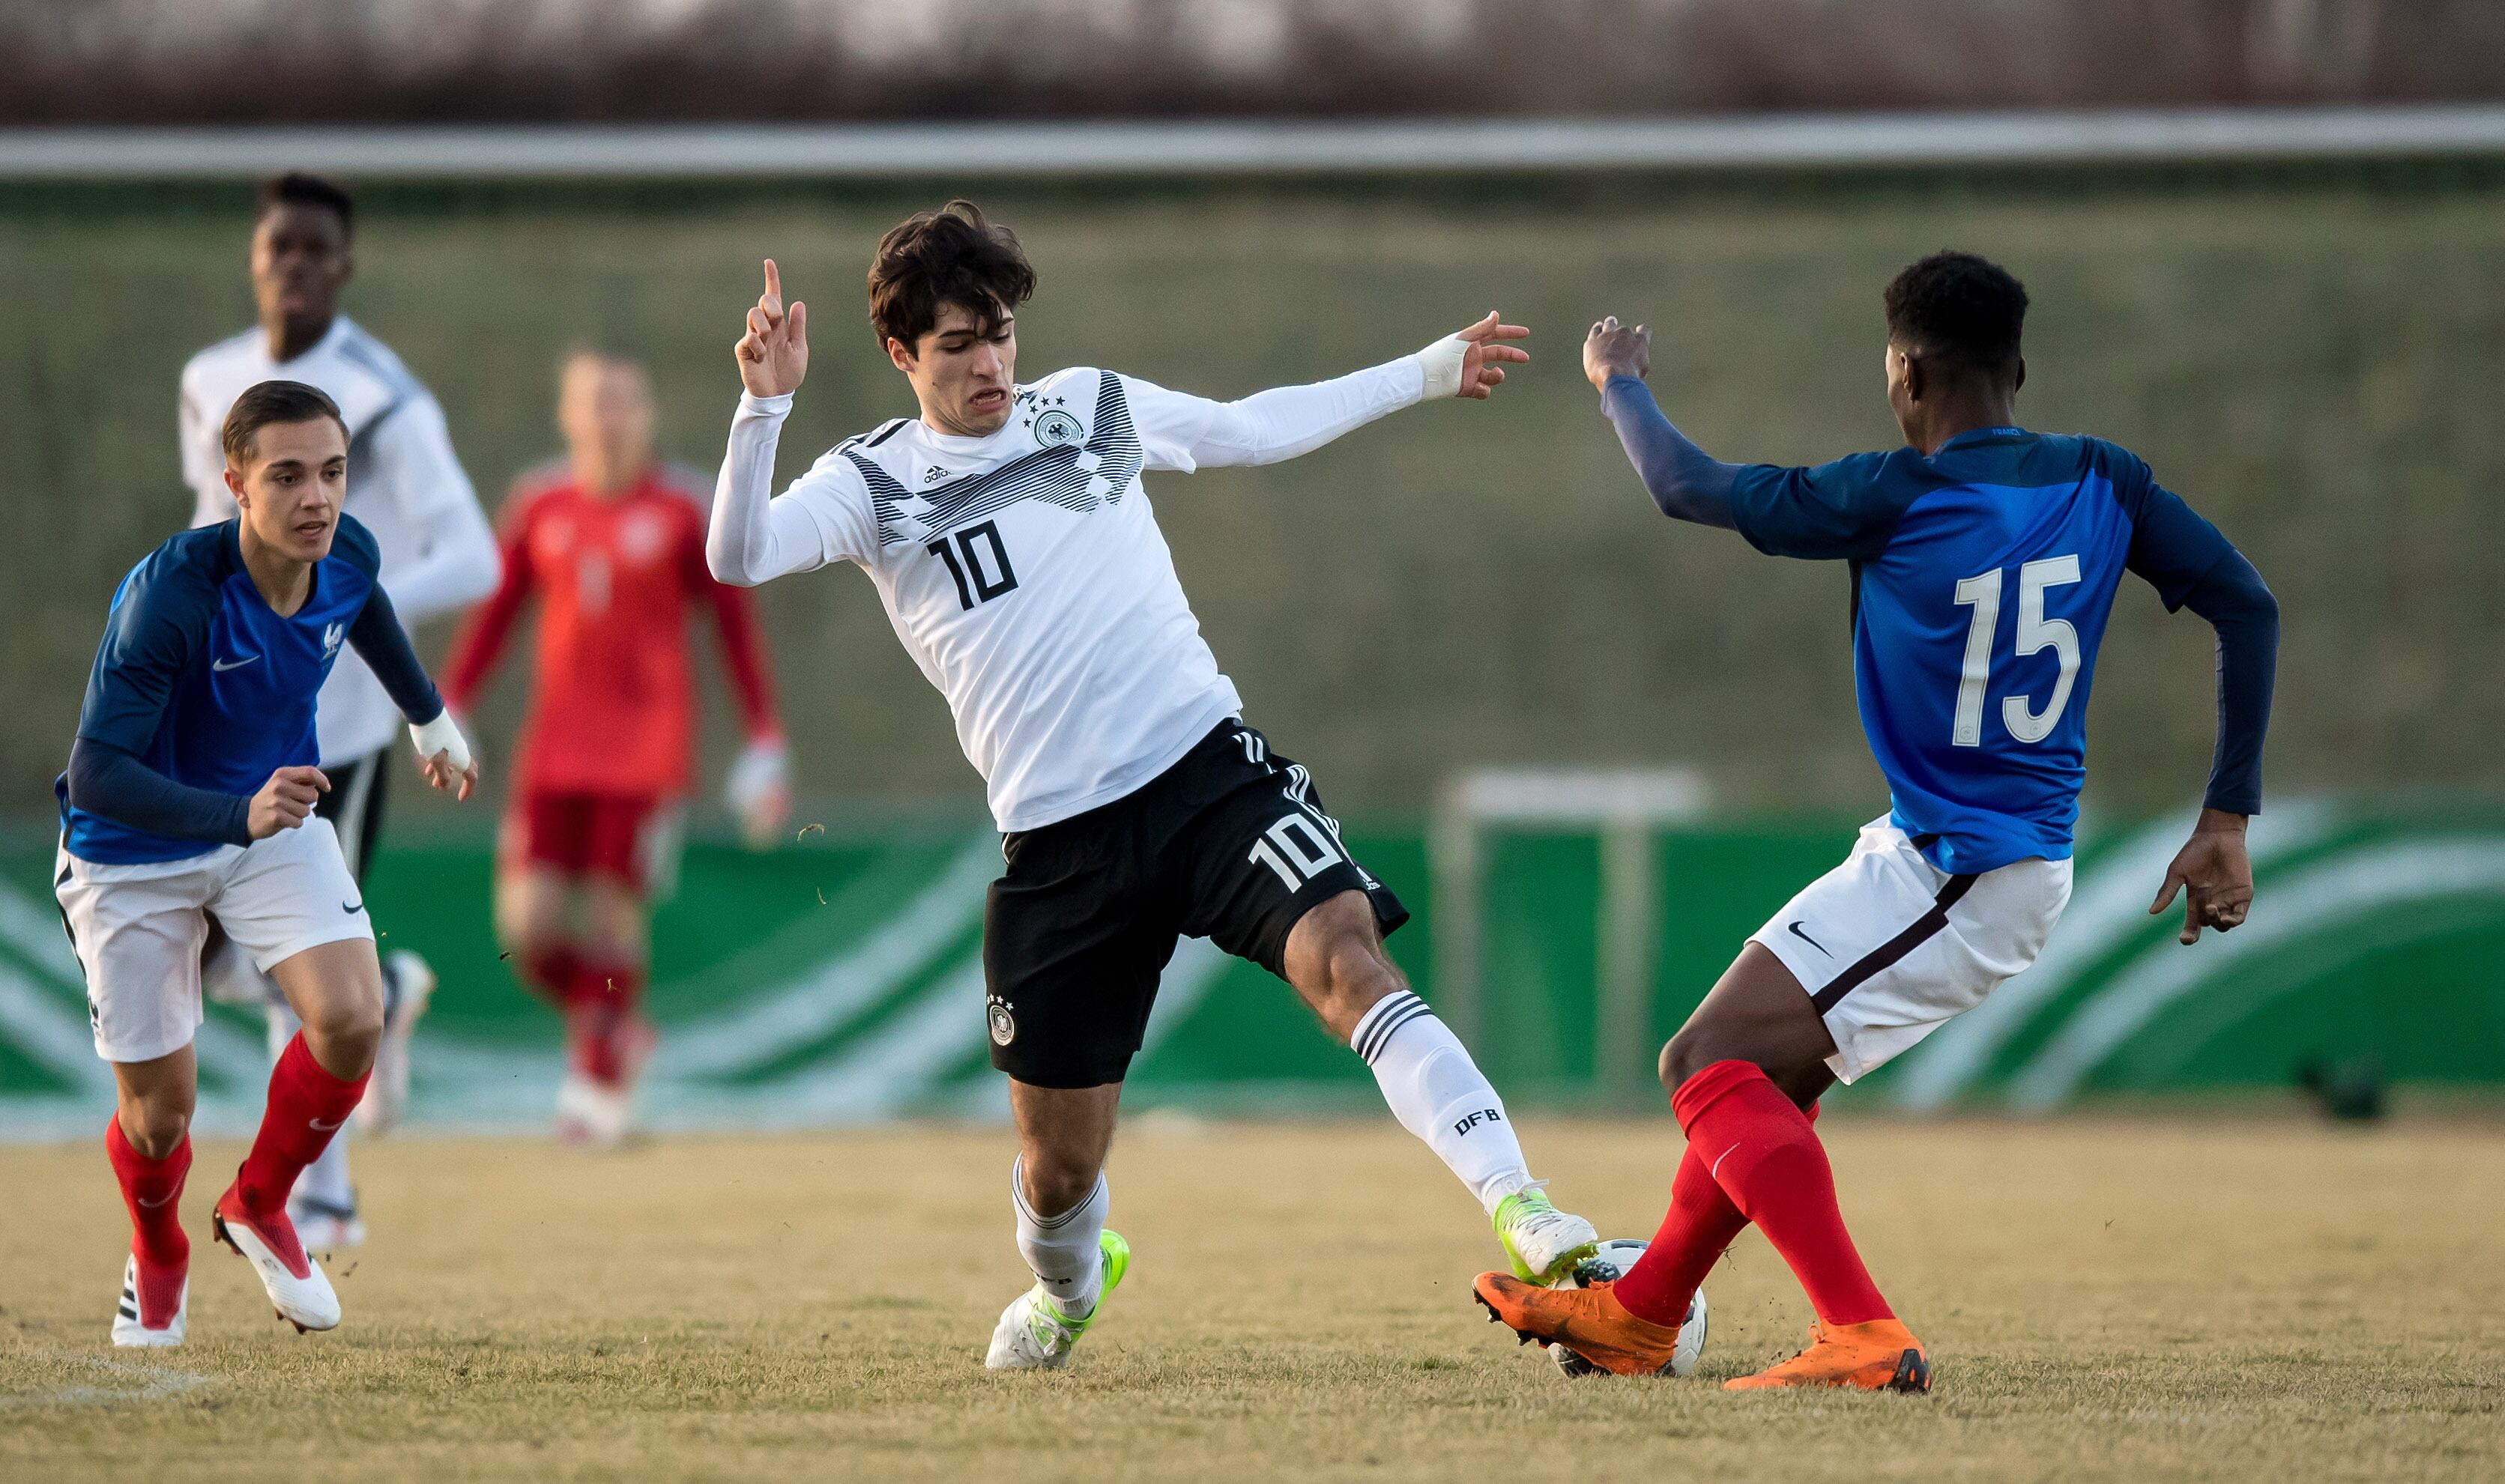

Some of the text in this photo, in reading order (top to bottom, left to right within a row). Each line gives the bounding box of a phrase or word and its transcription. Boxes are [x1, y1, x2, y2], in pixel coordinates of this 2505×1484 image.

[926, 518, 1019, 611] 10
[1952, 554, 2081, 747] 15
[1248, 813, 1343, 894] 10
[1454, 1109, 1501, 1136] DFB
